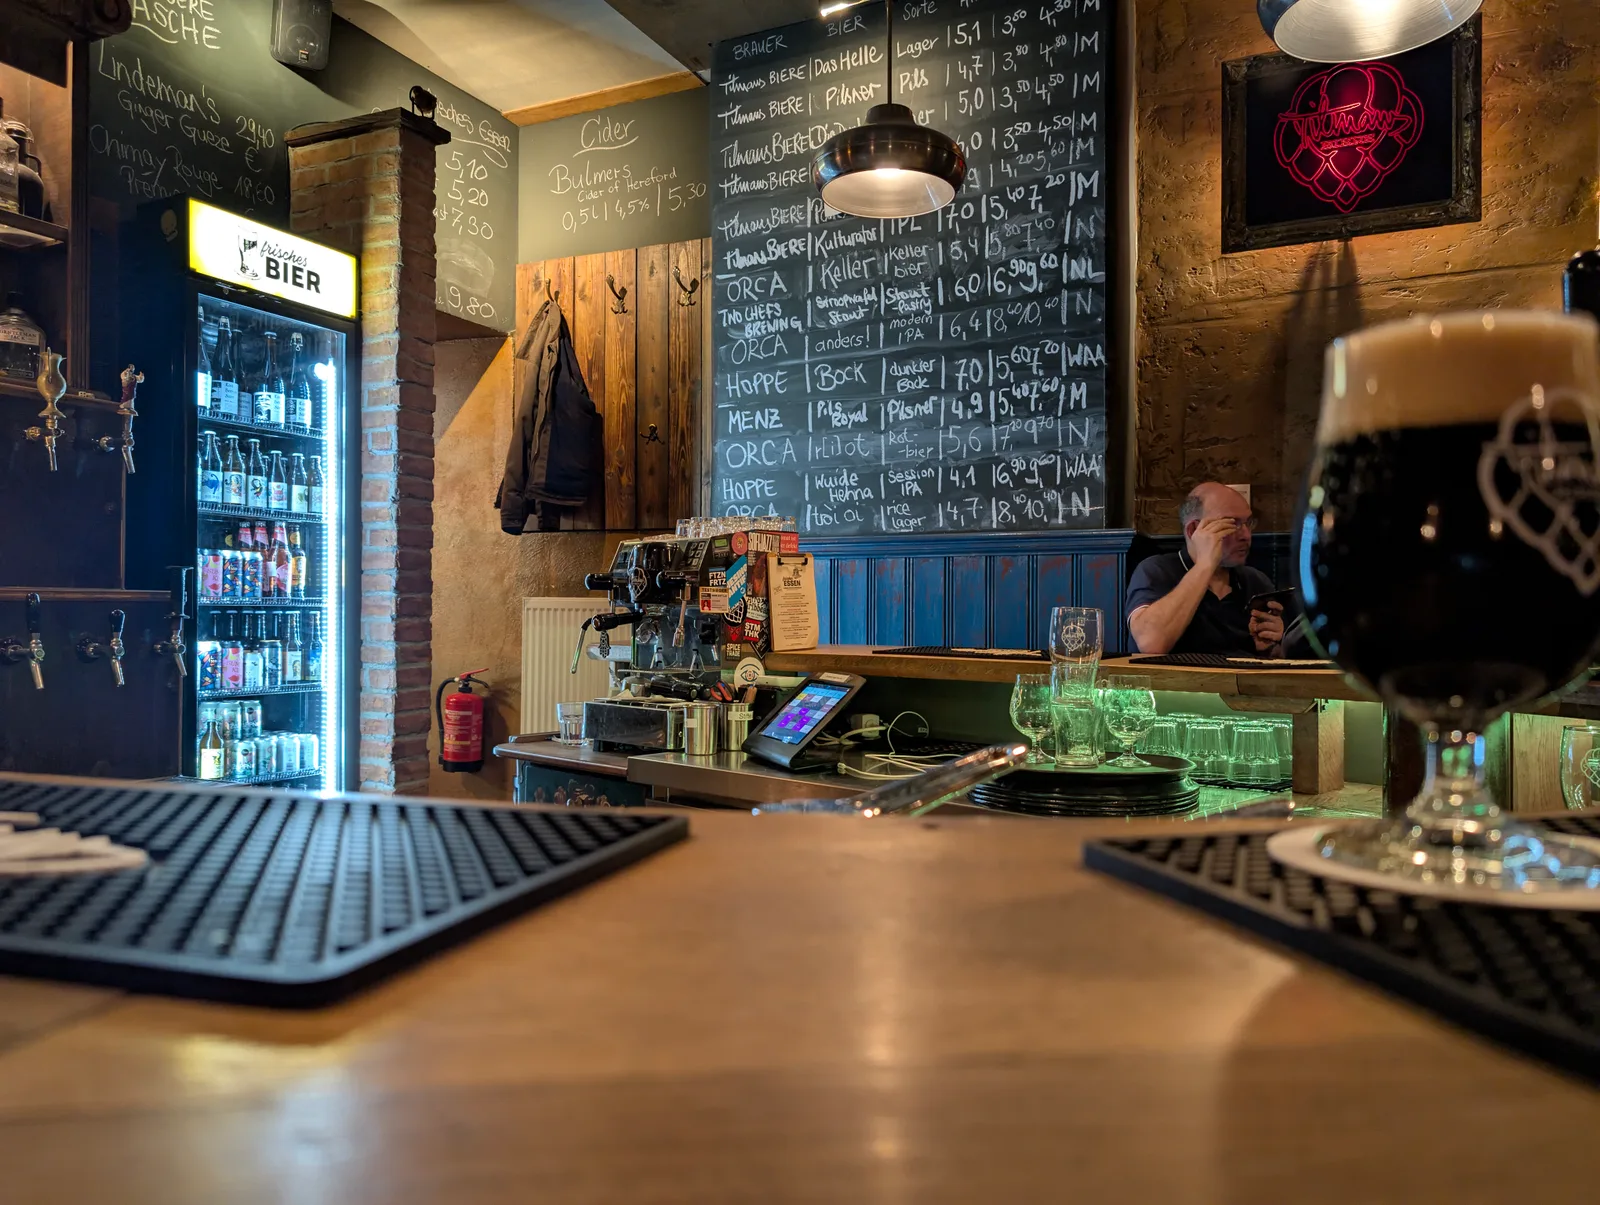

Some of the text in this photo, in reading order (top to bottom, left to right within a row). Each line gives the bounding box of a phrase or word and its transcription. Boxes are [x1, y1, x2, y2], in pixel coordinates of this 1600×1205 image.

[732, 1, 938, 60] BRAUER BIER Sorte
[769, 64, 806, 85] BIERE
[814, 58, 837, 77] Das
[840, 45, 884, 71] Helle
[896, 36, 939, 58] Lager
[954, 20, 981, 46] 5,1
[99, 39, 220, 125] Lindeman's
[768, 96, 805, 118] BIERE
[826, 82, 882, 109] Pilsner
[899, 67, 929, 94] Pils
[958, 55, 983, 83] 4,7
[1002, 44, 1029, 72] 3,80
[1081, 31, 1099, 54] M
[118, 90, 174, 134] Ginger
[236, 115, 275, 150] 29,40
[581, 114, 637, 150] Cider
[772, 132, 809, 162] BIERE
[958, 87, 984, 116] 5,0
[1035, 74, 1065, 106] 4,50
[1082, 71, 1100, 94] M
[245, 147, 262, 173] €
[445, 151, 488, 181] 5,10
[767, 166, 808, 191] BIERE
[1004, 122, 1031, 152] 3,50
[1038, 115, 1072, 146] 4,50
[1081, 112, 1097, 133] M
[166, 145, 223, 198] Rouge
[548, 159, 632, 195] Bulmers
[577, 166, 678, 203] Cider of Hereford
[770, 204, 806, 228] BIERE
[1000, 153, 1034, 178] 4,20
[1076, 136, 1094, 160] M
[447, 179, 489, 208] 5,20
[615, 197, 650, 222] 4,5%
[668, 182, 707, 212] 5,30
[451, 207, 493, 240] 7,30
[767, 237, 806, 260] BIERE
[814, 224, 877, 258] Kulturator
[1077, 170, 1099, 200] M
[259, 240, 308, 268] frisches
[727, 270, 788, 302] ORCA
[820, 255, 876, 290] Keller
[950, 236, 978, 262] 5,4
[1075, 214, 1095, 244] N
[895, 261, 928, 278] bier
[266, 256, 321, 294] BIER
[744, 302, 782, 322] CHEFS
[885, 284, 931, 304] Stout
[954, 273, 981, 302] 6,0
[1070, 255, 1105, 280] NL
[447, 286, 494, 318] 9,80
[828, 305, 870, 326] Stout
[731, 333, 788, 365] ORCA
[814, 325, 870, 353] anders!
[889, 313, 934, 329] modern
[950, 310, 982, 341] 6,4
[1075, 287, 1092, 315] N
[898, 328, 925, 346] IPA
[726, 369, 788, 398] HOPPE
[889, 357, 936, 377] dunkler
[955, 357, 984, 392] 7,0
[728, 408, 783, 434] MENZ
[817, 399, 843, 418] Pils
[886, 396, 938, 422] Pilsner
[951, 391, 983, 420] 4,9
[1070, 382, 1087, 410] M
[831, 402, 868, 429] Royal
[726, 437, 797, 468] ORCA
[946, 425, 982, 459] 5,6
[1068, 417, 1089, 447] N
[722, 478, 777, 502] HOPPE
[887, 467, 935, 483] Session
[949, 465, 976, 488] 4,1
[1064, 453, 1102, 478] WAA
[901, 481, 923, 497] IPA
[887, 500, 911, 516] rice
[947, 497, 983, 527] 4,7
[1071, 487, 1089, 517] N
[892, 515, 927, 532] lager
[709, 571, 726, 580] FTZN
[709, 578, 727, 587] FRTZ
[744, 628, 760, 638] THK
[745, 621, 761, 631] STM
[726, 649, 741, 657] TRADE
